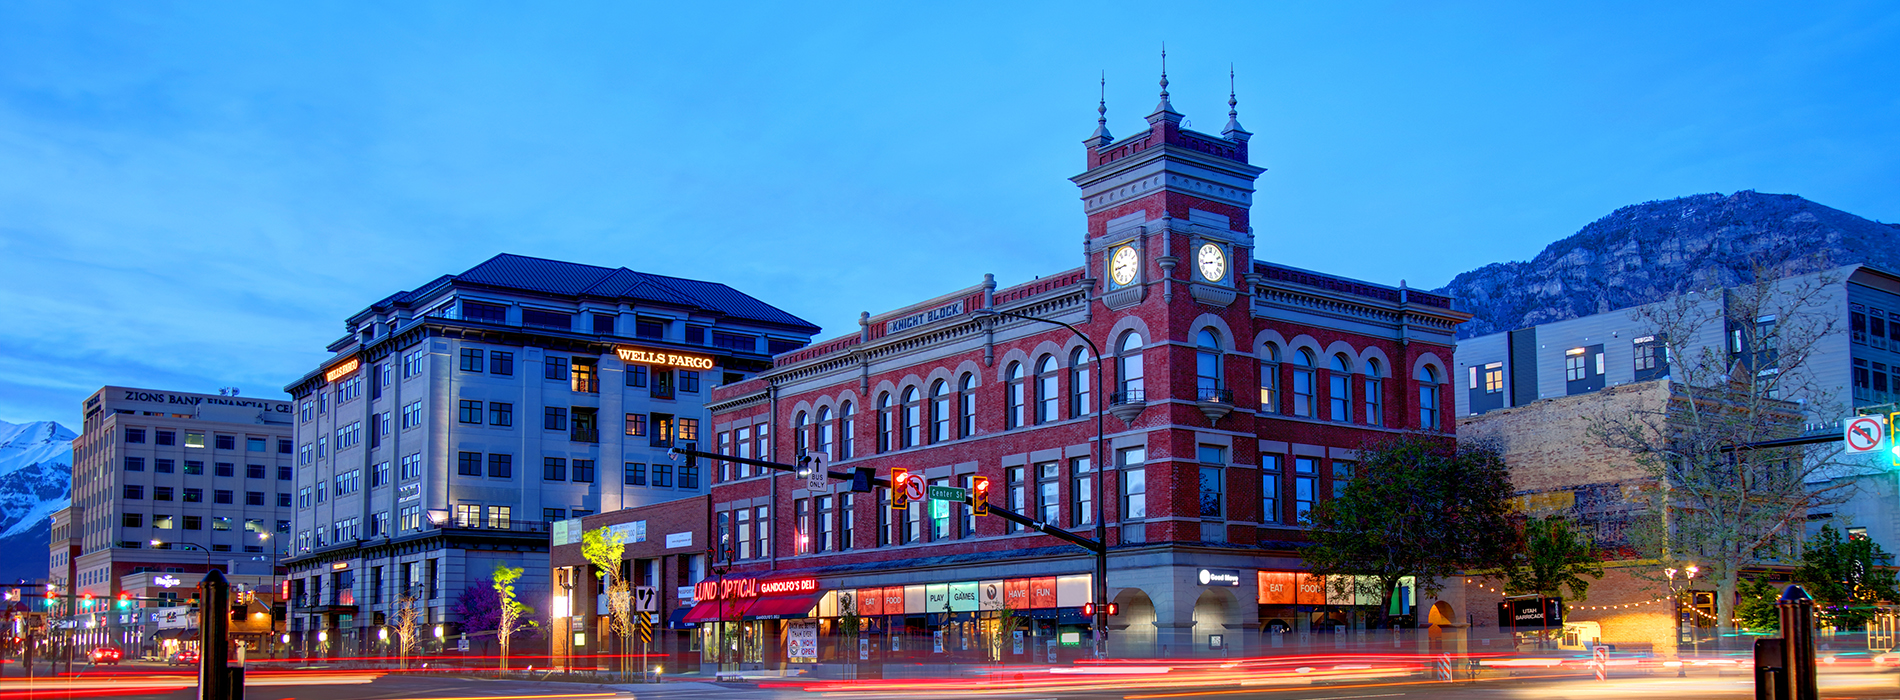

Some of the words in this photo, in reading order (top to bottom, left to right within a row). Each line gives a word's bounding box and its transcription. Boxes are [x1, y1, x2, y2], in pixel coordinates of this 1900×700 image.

[893, 314, 924, 331] KNIGHT
[928, 304, 958, 321] BLOCK
[617, 349, 666, 364] WELLS
[668, 354, 713, 369] FARGO
[125, 391, 165, 403] ZIONS
[809, 481, 825, 489] ONLY
[931, 488, 953, 498] Center
[956, 490, 963, 499] St
[694, 582, 718, 601] LUND
[720, 578, 757, 600] OPTICAL
[761, 580, 800, 593] GANDOLFO'S
[801, 579, 815, 590] DELI
[1270, 583, 1284, 592] EAT
[930, 594, 945, 602] PLAY
[954, 592, 975, 601] GAMES
[1008, 589, 1026, 598] HAVE
[1036, 588, 1051, 597] FUN
[865, 597, 876, 606] EAT
[886, 597, 902, 605] FOOD
[801, 648, 815, 656] OPEN
